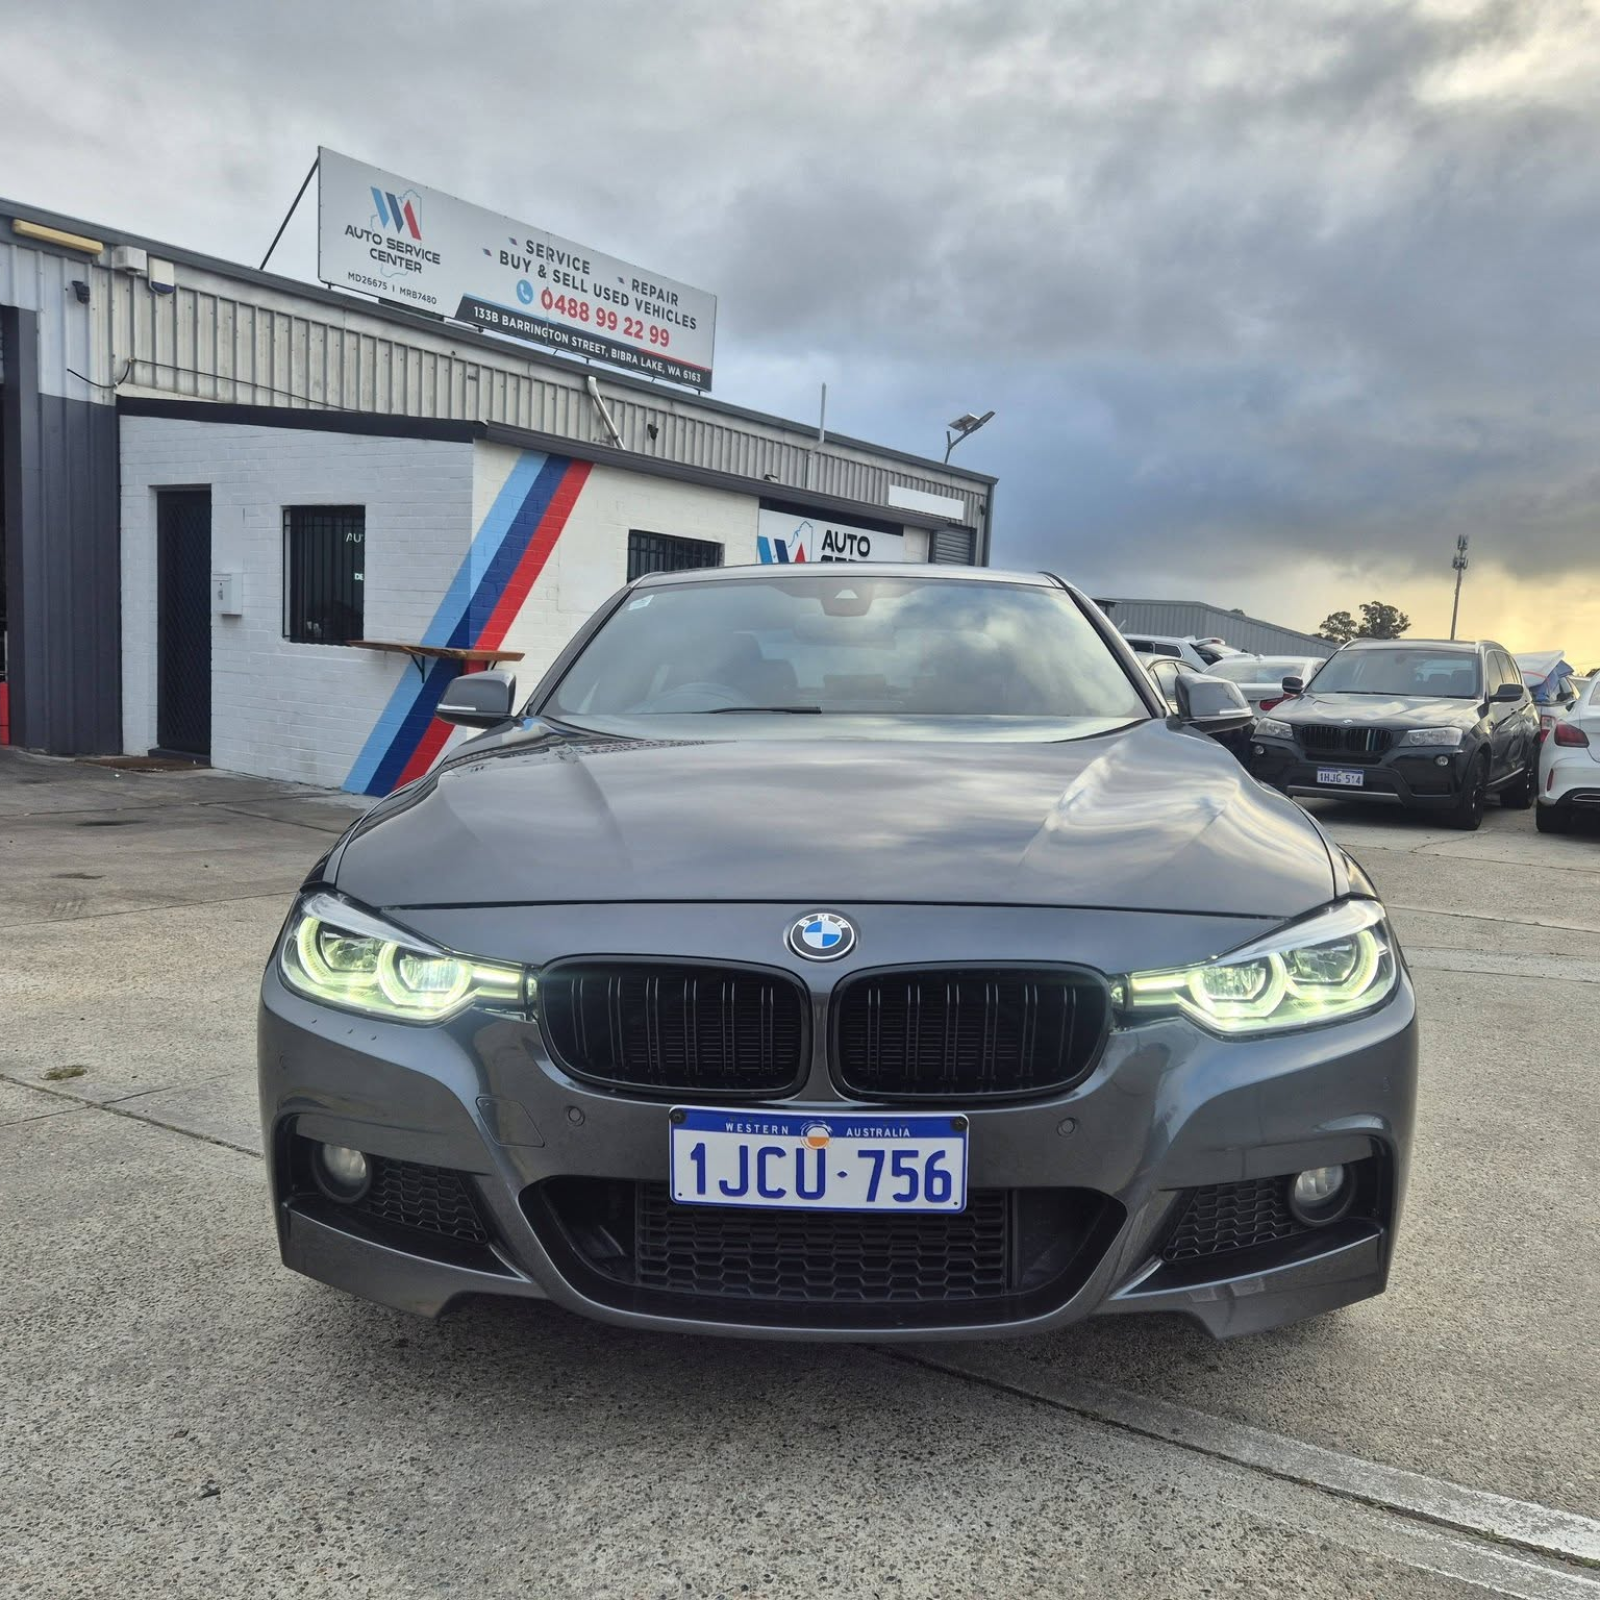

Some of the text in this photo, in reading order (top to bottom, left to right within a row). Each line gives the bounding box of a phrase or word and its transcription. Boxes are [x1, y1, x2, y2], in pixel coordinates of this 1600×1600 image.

[345, 224, 441, 265] AUTO SERVICE
[525, 239, 591, 275] SERVICE
[369, 247, 422, 274] CENTER
[347, 272, 388, 291] MD26675
[399, 286, 437, 305] MRB7480
[499, 250, 697, 330] BUY & SELL USED VEHICLES
[631, 278, 679, 307] REPAIR
[541, 288, 670, 348] 0488 99 22 99
[473, 306, 701, 383] 133B BARRINGTON STREET, BIBRA LAKE, WA 6163
[346, 532, 364, 543] AU
[821, 529, 871, 557] AUTO
[798, 914, 849, 929] BMW
[725, 1122, 911, 1138] WESTERN AUSTRALIA
